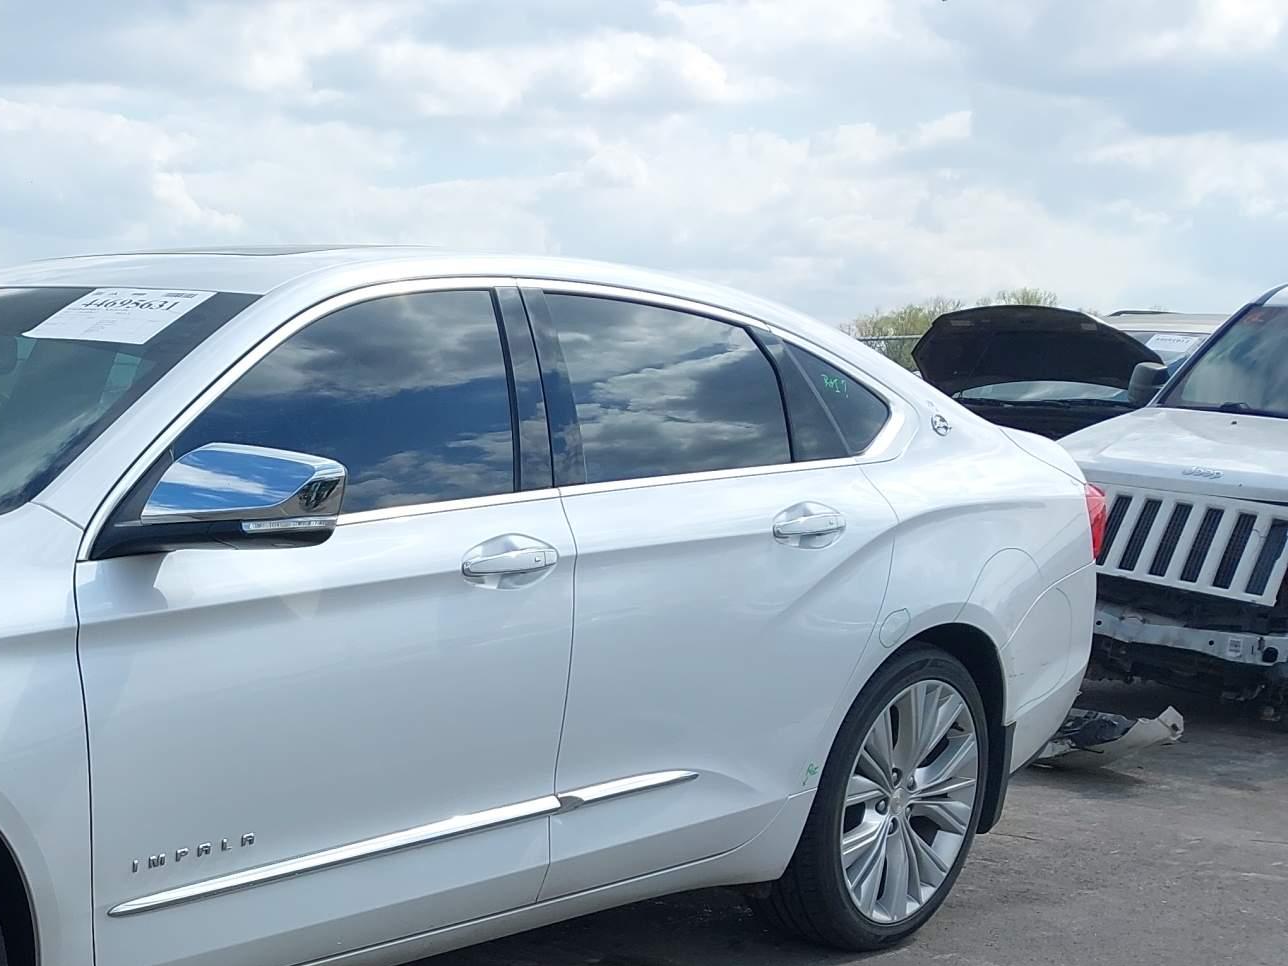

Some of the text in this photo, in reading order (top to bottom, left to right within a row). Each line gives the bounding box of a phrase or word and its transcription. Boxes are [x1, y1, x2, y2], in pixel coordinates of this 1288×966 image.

[81, 299, 180, 311] 44695631
[1182, 465, 1224, 480] Jeep
[132, 832, 255, 873] IMPALA
